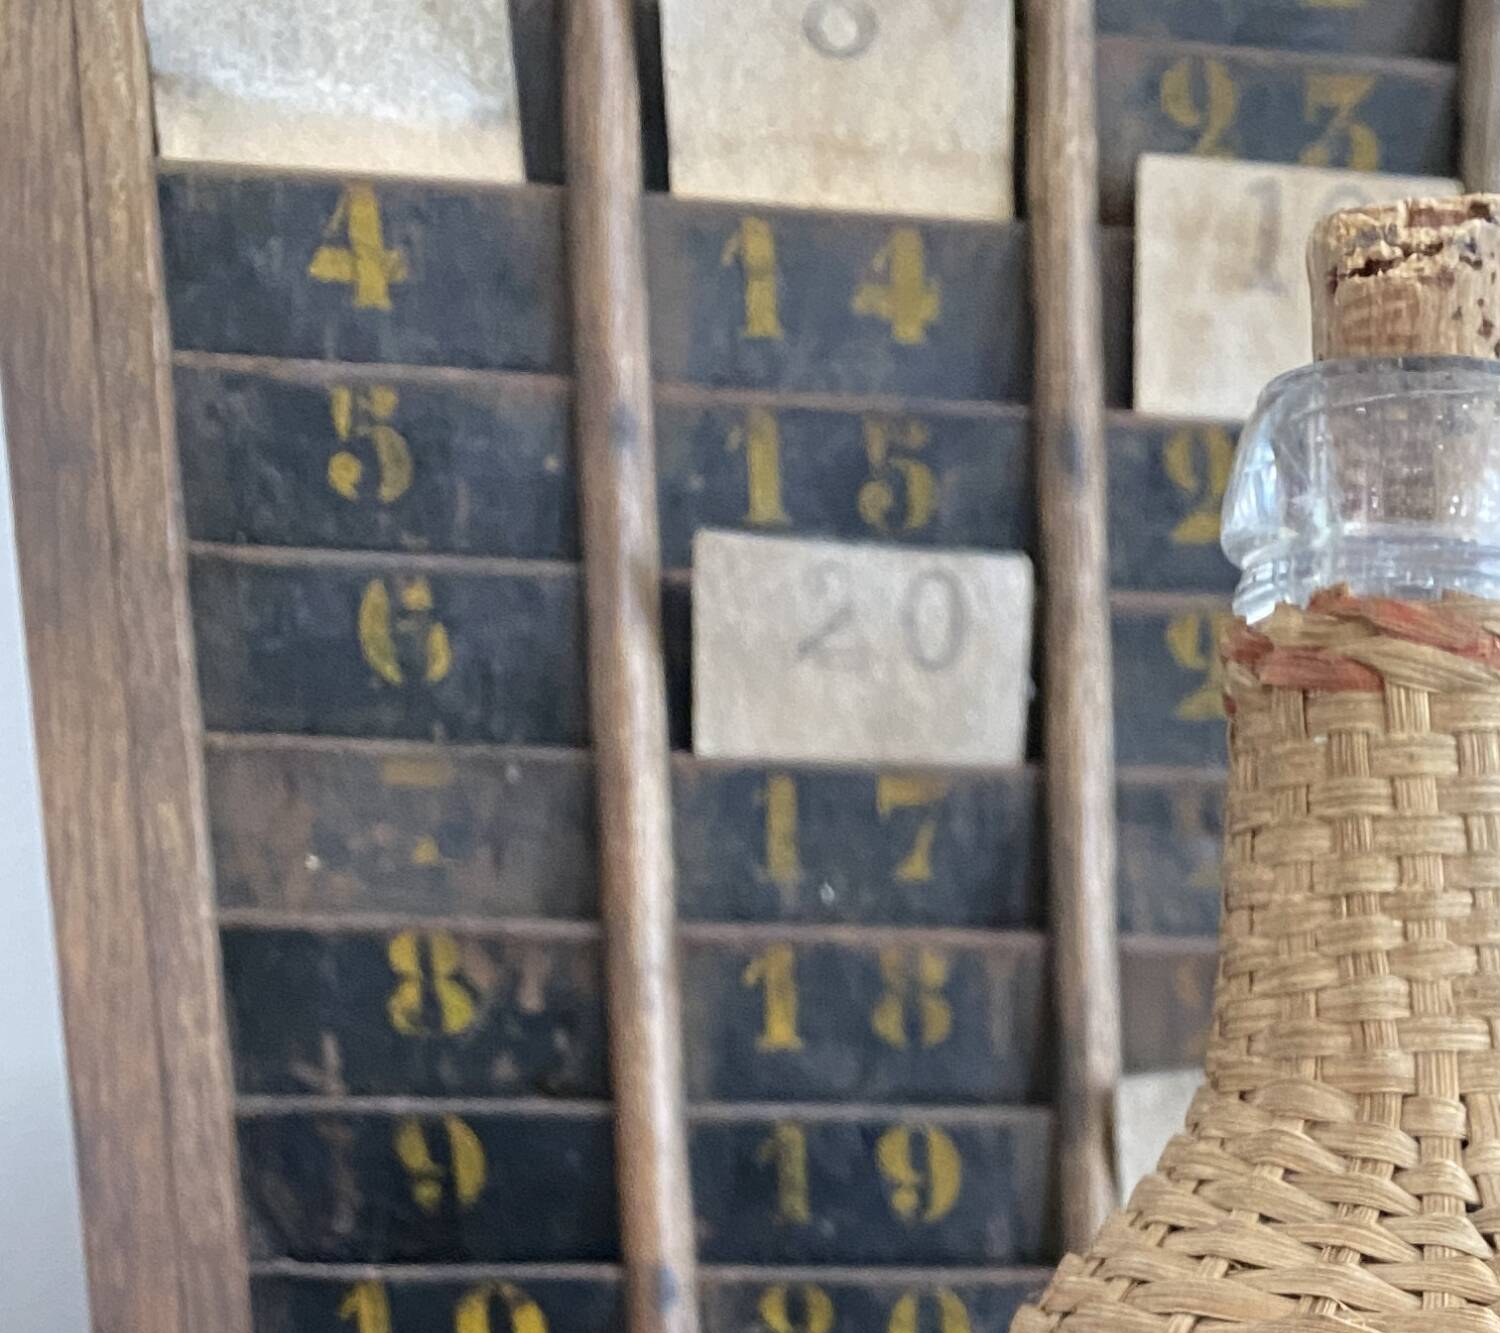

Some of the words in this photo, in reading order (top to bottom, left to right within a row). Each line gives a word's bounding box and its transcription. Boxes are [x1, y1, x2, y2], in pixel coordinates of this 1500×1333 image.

[309, 181, 406, 310] 4
[722, 217, 941, 344] 14
[328, 386, 413, 503] 5
[727, 408, 936, 531] 15
[358, 577, 451, 684] 6
[798, 559, 970, 673] 20
[760, 774, 948, 884] 17
[387, 931, 475, 1036] 8
[742, 942, 952, 1053] 18
[397, 1114, 487, 1211] 9
[755, 1119, 962, 1225] 19
